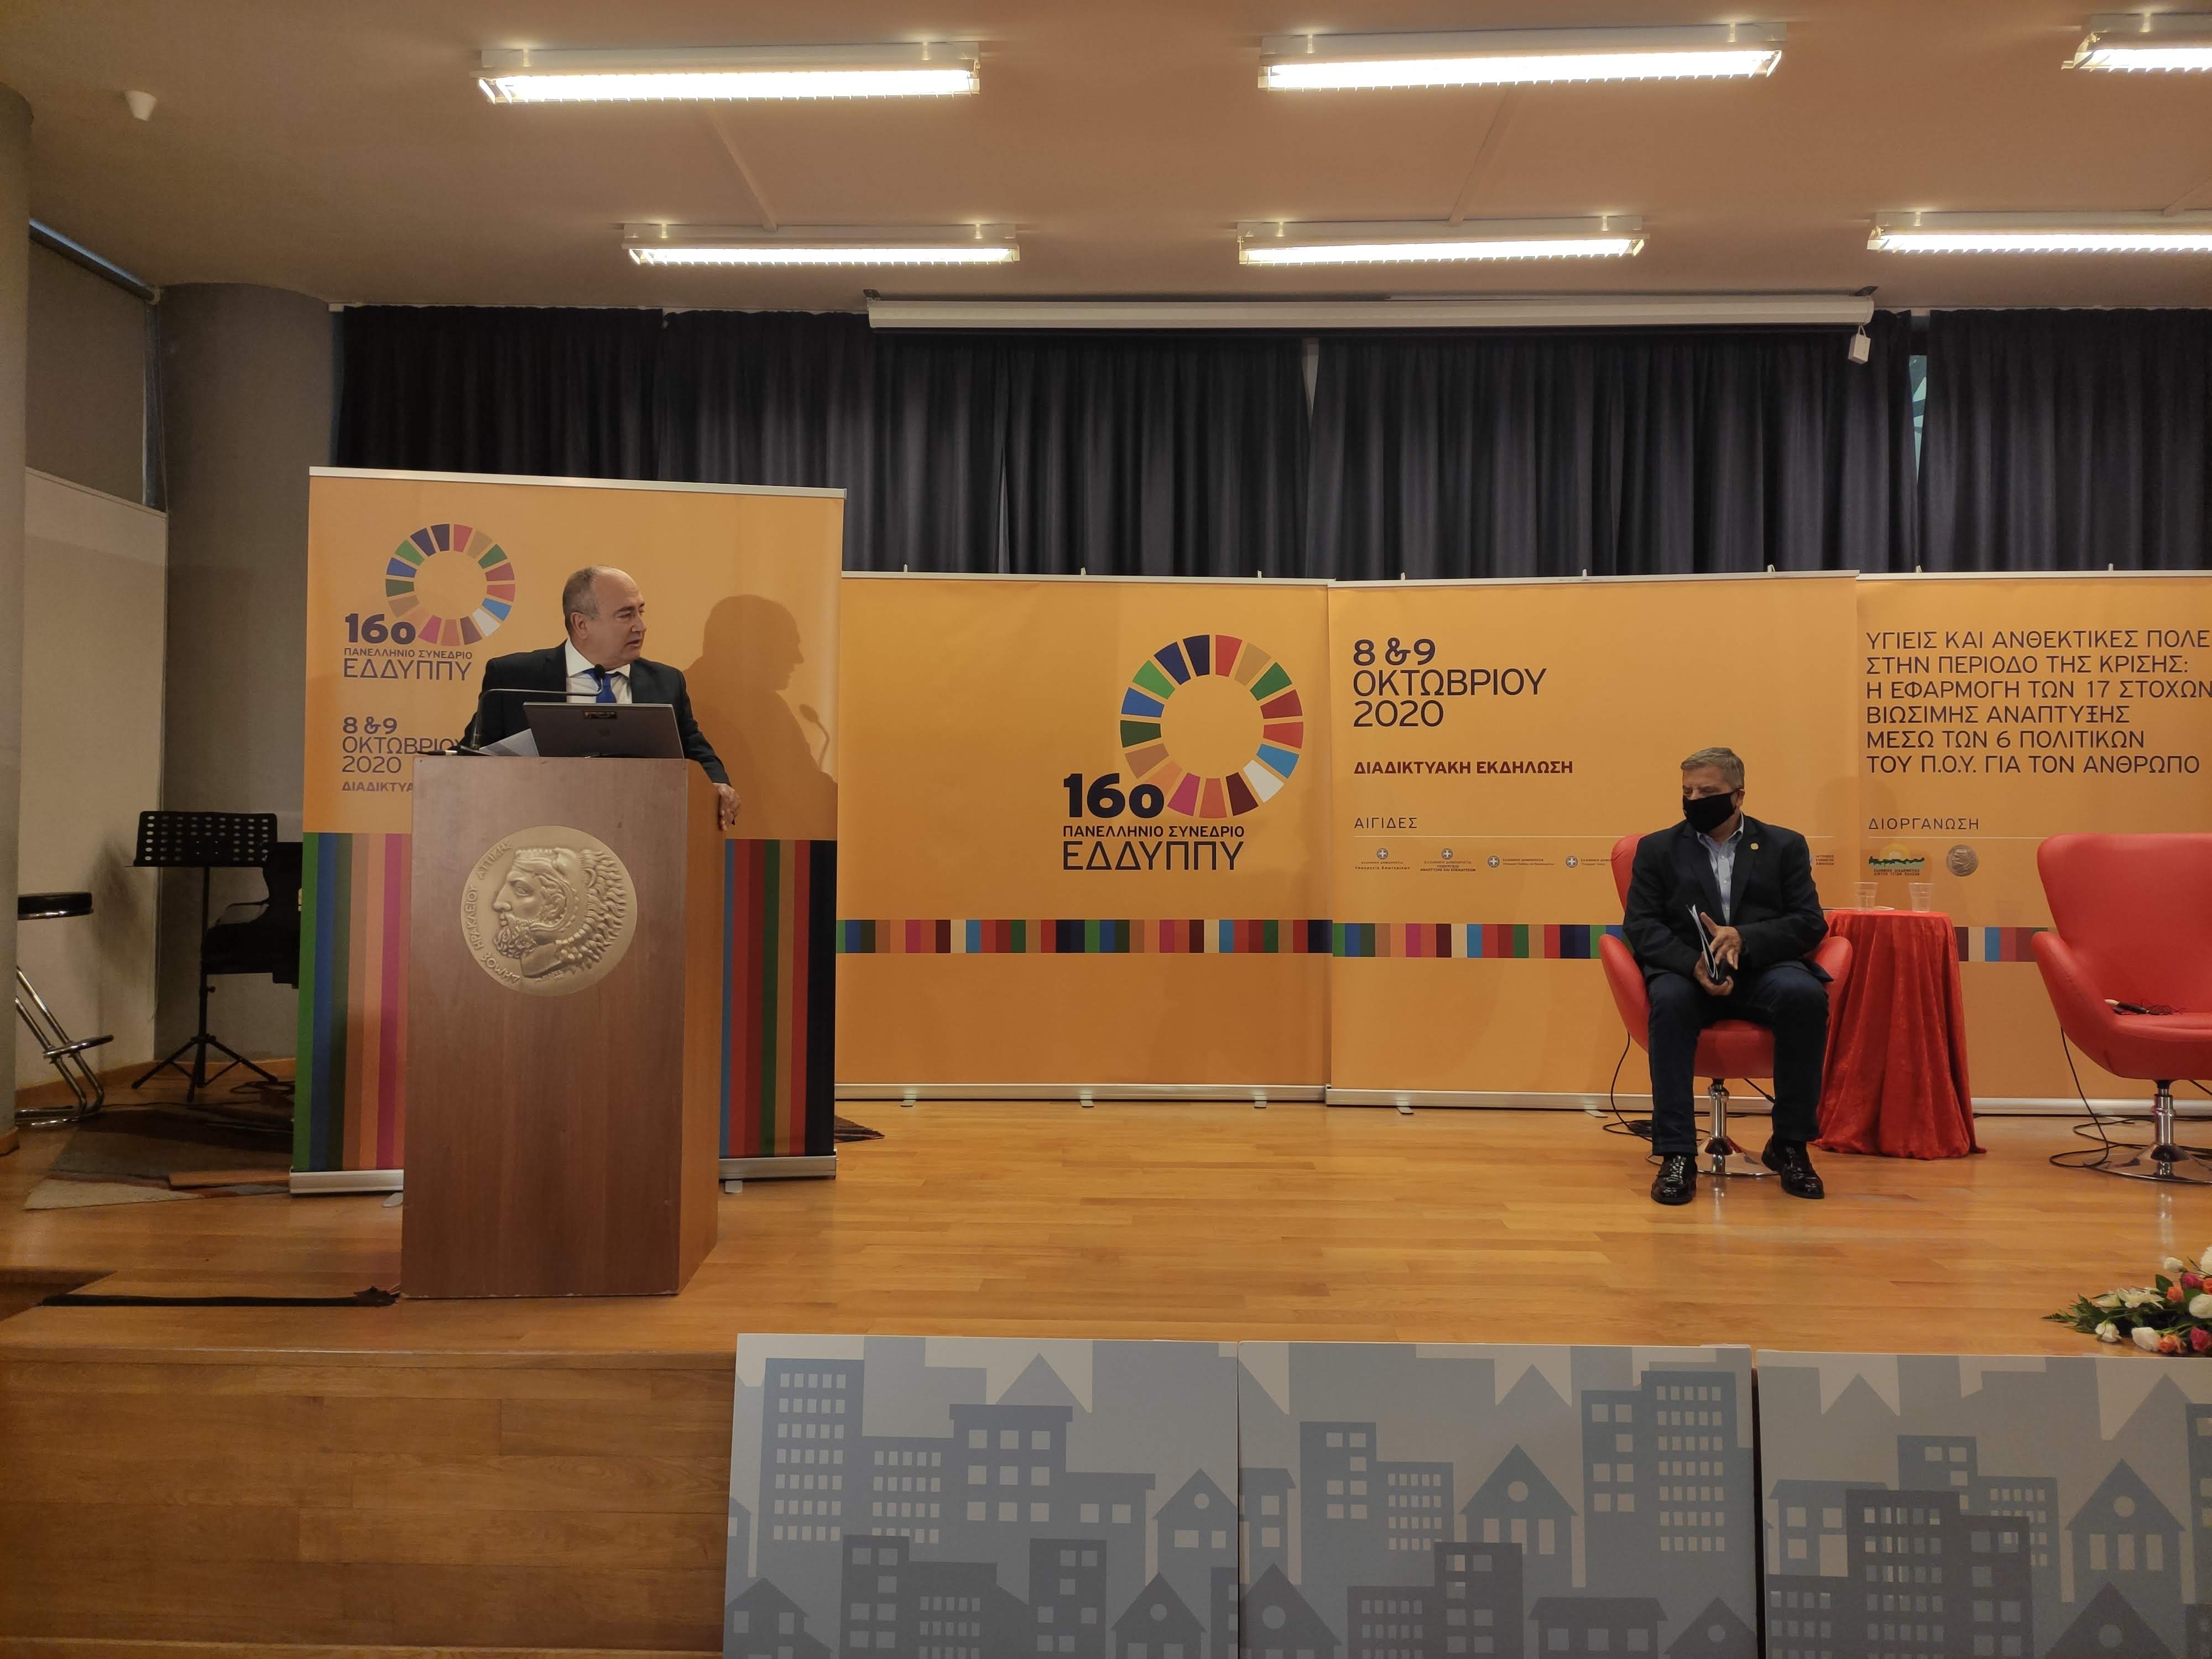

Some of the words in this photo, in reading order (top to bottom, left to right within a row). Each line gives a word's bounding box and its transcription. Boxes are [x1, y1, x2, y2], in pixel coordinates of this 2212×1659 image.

[1866, 632, 1937, 649] ΥΓΙΕΙΣ
[1945, 632, 1983, 648] ΚΑΙ
[1992, 630, 2138, 649] ΑΝΘΕΚΤΙΚΕΣ
[2147, 630, 2210, 648] ΠΟΛΕ
[345, 648, 415, 658] ΠΑΝΕΛΛΗΝΙΟ
[419, 650, 472, 660] ΣΥΝΕΔΡΙΟ
[1353, 639, 1376, 666] 8
[344, 657, 472, 681] ΕΔΔΥΠΠΥ
[1866, 656, 1929, 674] ΣΤΗΝ
[1938, 656, 2038, 674] ΠΕΡΙΟΔΟ
[2046, 656, 2091, 673] ΤΗΣ
[2100, 655, 2188, 672] ΚΡΙΣΗΣ:
[1353, 668, 1547, 697] ΟΚΤΩΒΡΙΟΥ
[1867, 682, 1881, 699] Η
[1891, 681, 2020, 698] ΕΦΑΡΜΟΓΗ
[2028, 681, 2074, 698] ΤΩΝ
[2088, 681, 2110, 698] 17
[2119, 680, 2212, 698] ΣΤΟΧΩΝ
[1353, 700, 1444, 727] 2020
[1867, 706, 1979, 723] ΒΙΩΣΙΜΗΣ
[1986, 706, 2130, 723] ΑΝΑΠΤΥΞΗΣ
[343, 716, 358, 734] 8
[342, 736, 460, 754] ΟΚΤΩΒΡΙΟ
[1867, 731, 1934, 748] ΜΕΣΩ
[1942, 731, 1987, 748] ΤΩΝ
[1996, 731, 2011, 748] 6
[2020, 731, 2144, 748] ΠΟΛΙΤΙΚΩΝ
[342, 755, 401, 774] 2020
[1354, 761, 1471, 774] ΔΙΑΔΙΚΤΥΑΚΗ
[1477, 761, 1573, 774] ΕΚΔΗΛΩΣΗ
[1866, 756, 1912, 773] ΤΟΥ
[1921, 755, 1976, 773] Π.Ο.Υ.
[1985, 756, 2021, 773] ΓΙΑ
[2028, 755, 2074, 773] ΤΟΝ
[2083, 756, 2200, 773] ΑΝΘΡΩΠΟ
[1063, 826, 1164, 838] ΠΑΝΕΛΛΗΝΙΟ
[1168, 826, 1245, 838] ΣΥΝΕΔΡΙΟ
[1354, 817, 1417, 829] ΑΙΓΙΔΕΣ
[1868, 818, 1979, 830] ΔΙΟΡΓΑΝΩΣΗ
[1063, 841, 1244, 870] ΕΔΔΥΠΠΥ
